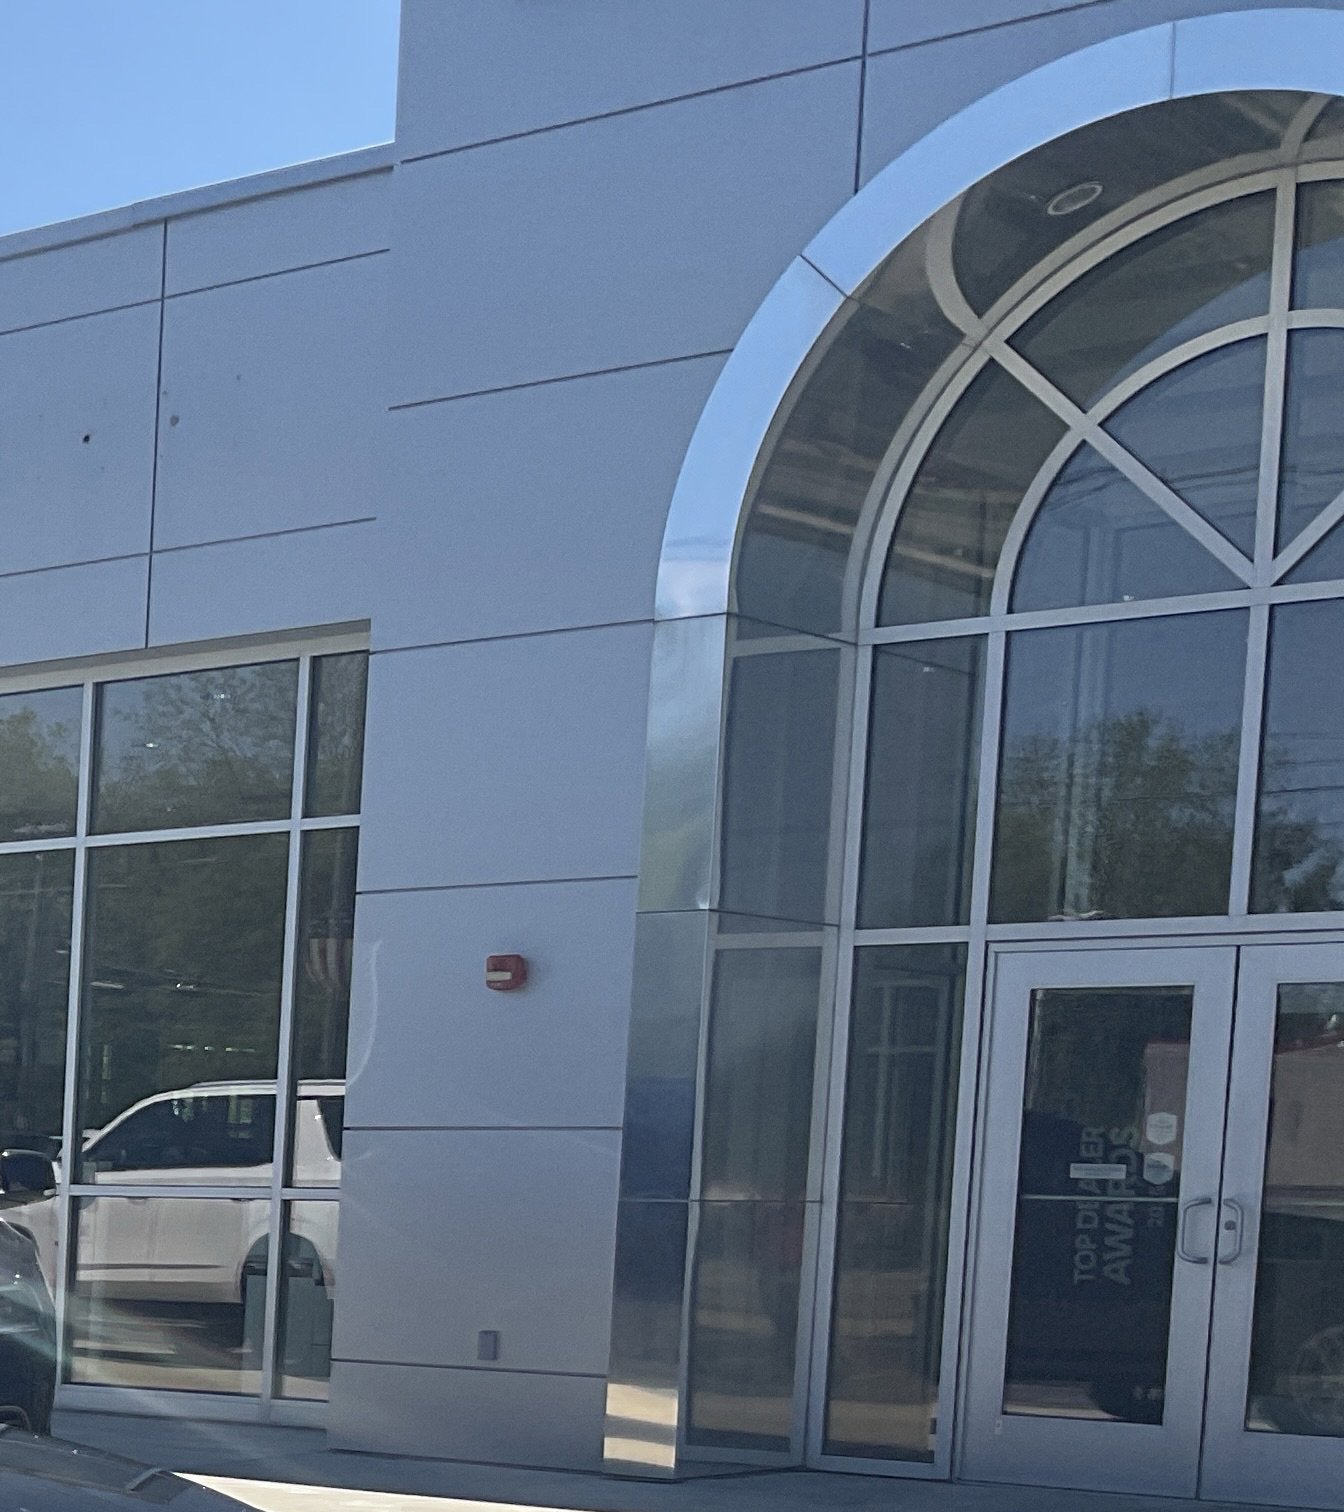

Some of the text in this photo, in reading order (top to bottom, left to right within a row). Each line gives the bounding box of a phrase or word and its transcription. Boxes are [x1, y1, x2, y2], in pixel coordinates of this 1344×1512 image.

[1076, 1126, 1106, 1229] DEAER
[1102, 1126, 1139, 1285] AWARDS
[1074, 1234, 1097, 1284] TOP
